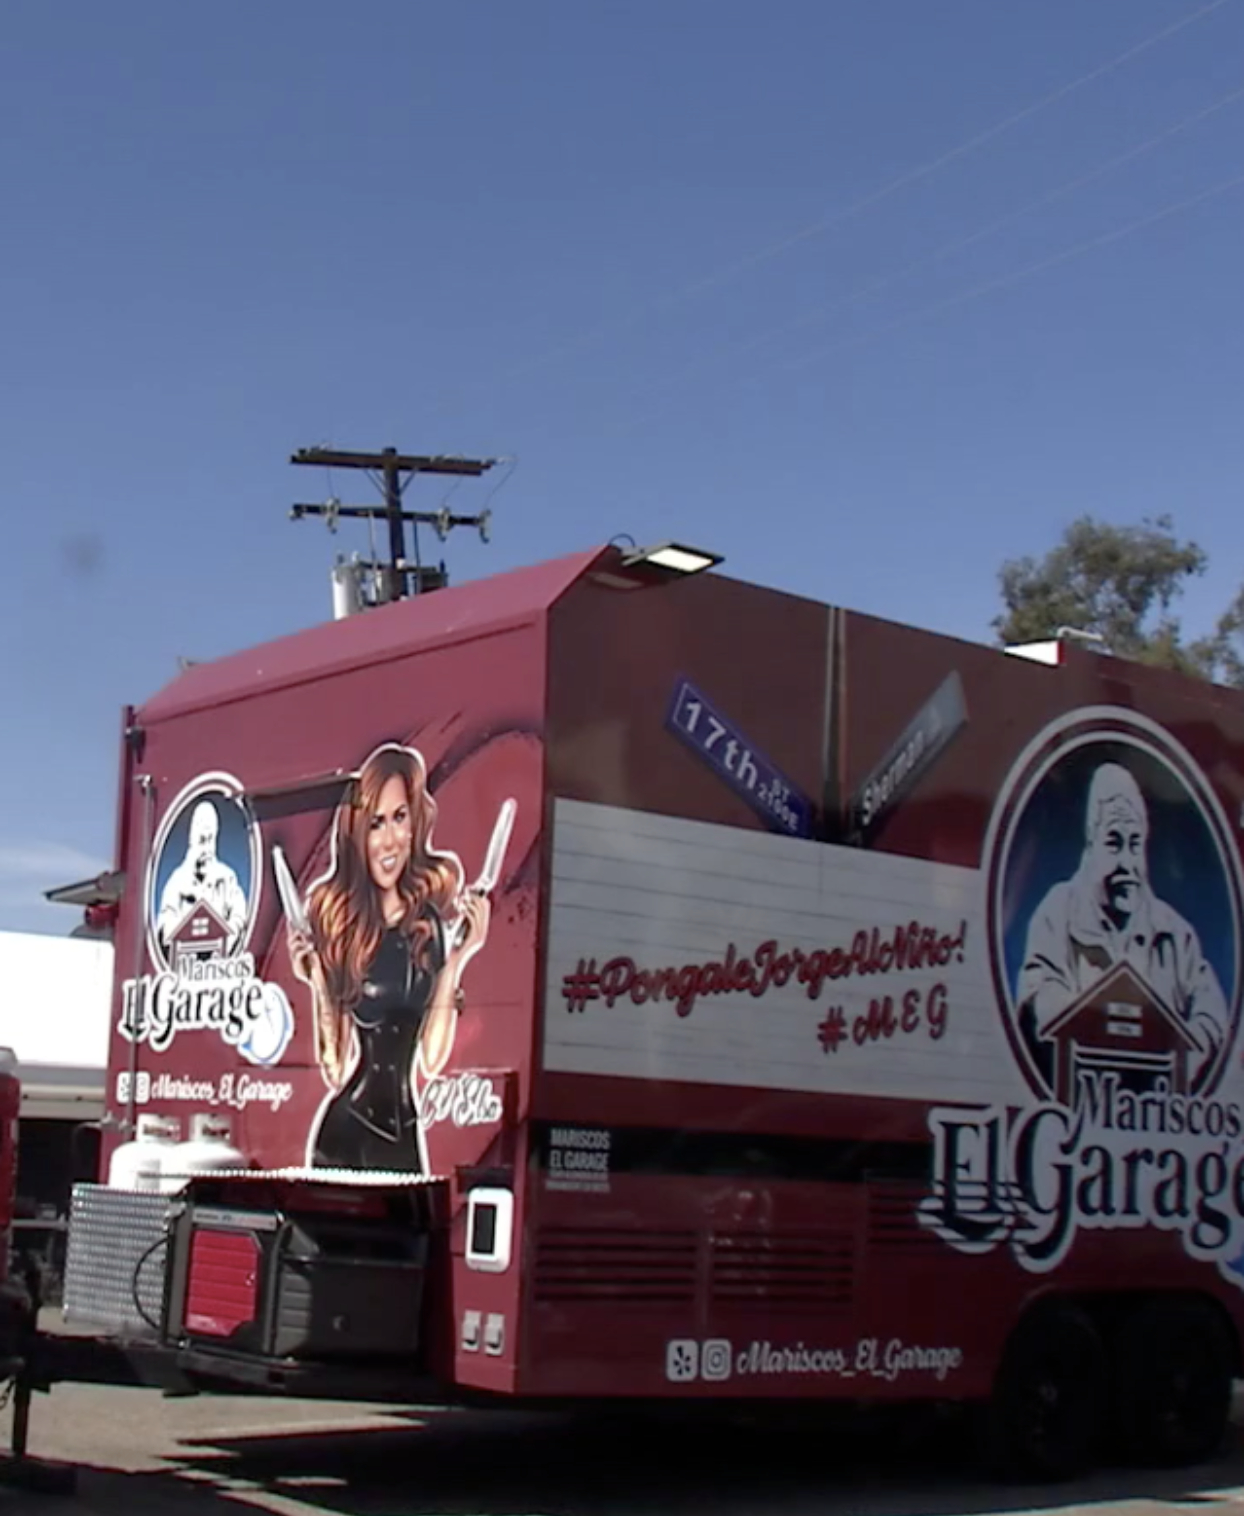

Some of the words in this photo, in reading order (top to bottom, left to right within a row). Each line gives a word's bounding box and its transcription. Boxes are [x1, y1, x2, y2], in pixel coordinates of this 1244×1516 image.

[684, 702, 759, 789] 17th
[861, 729, 924, 827] Sherman
[152, 975, 263, 1045] Garage
[1068, 1073, 1242, 1144] Mariscos
[919, 1109, 1012, 1242] El
[1014, 1107, 1244, 1261] Garag
[736, 1339, 963, 1382] Mariscos_El_Garage
